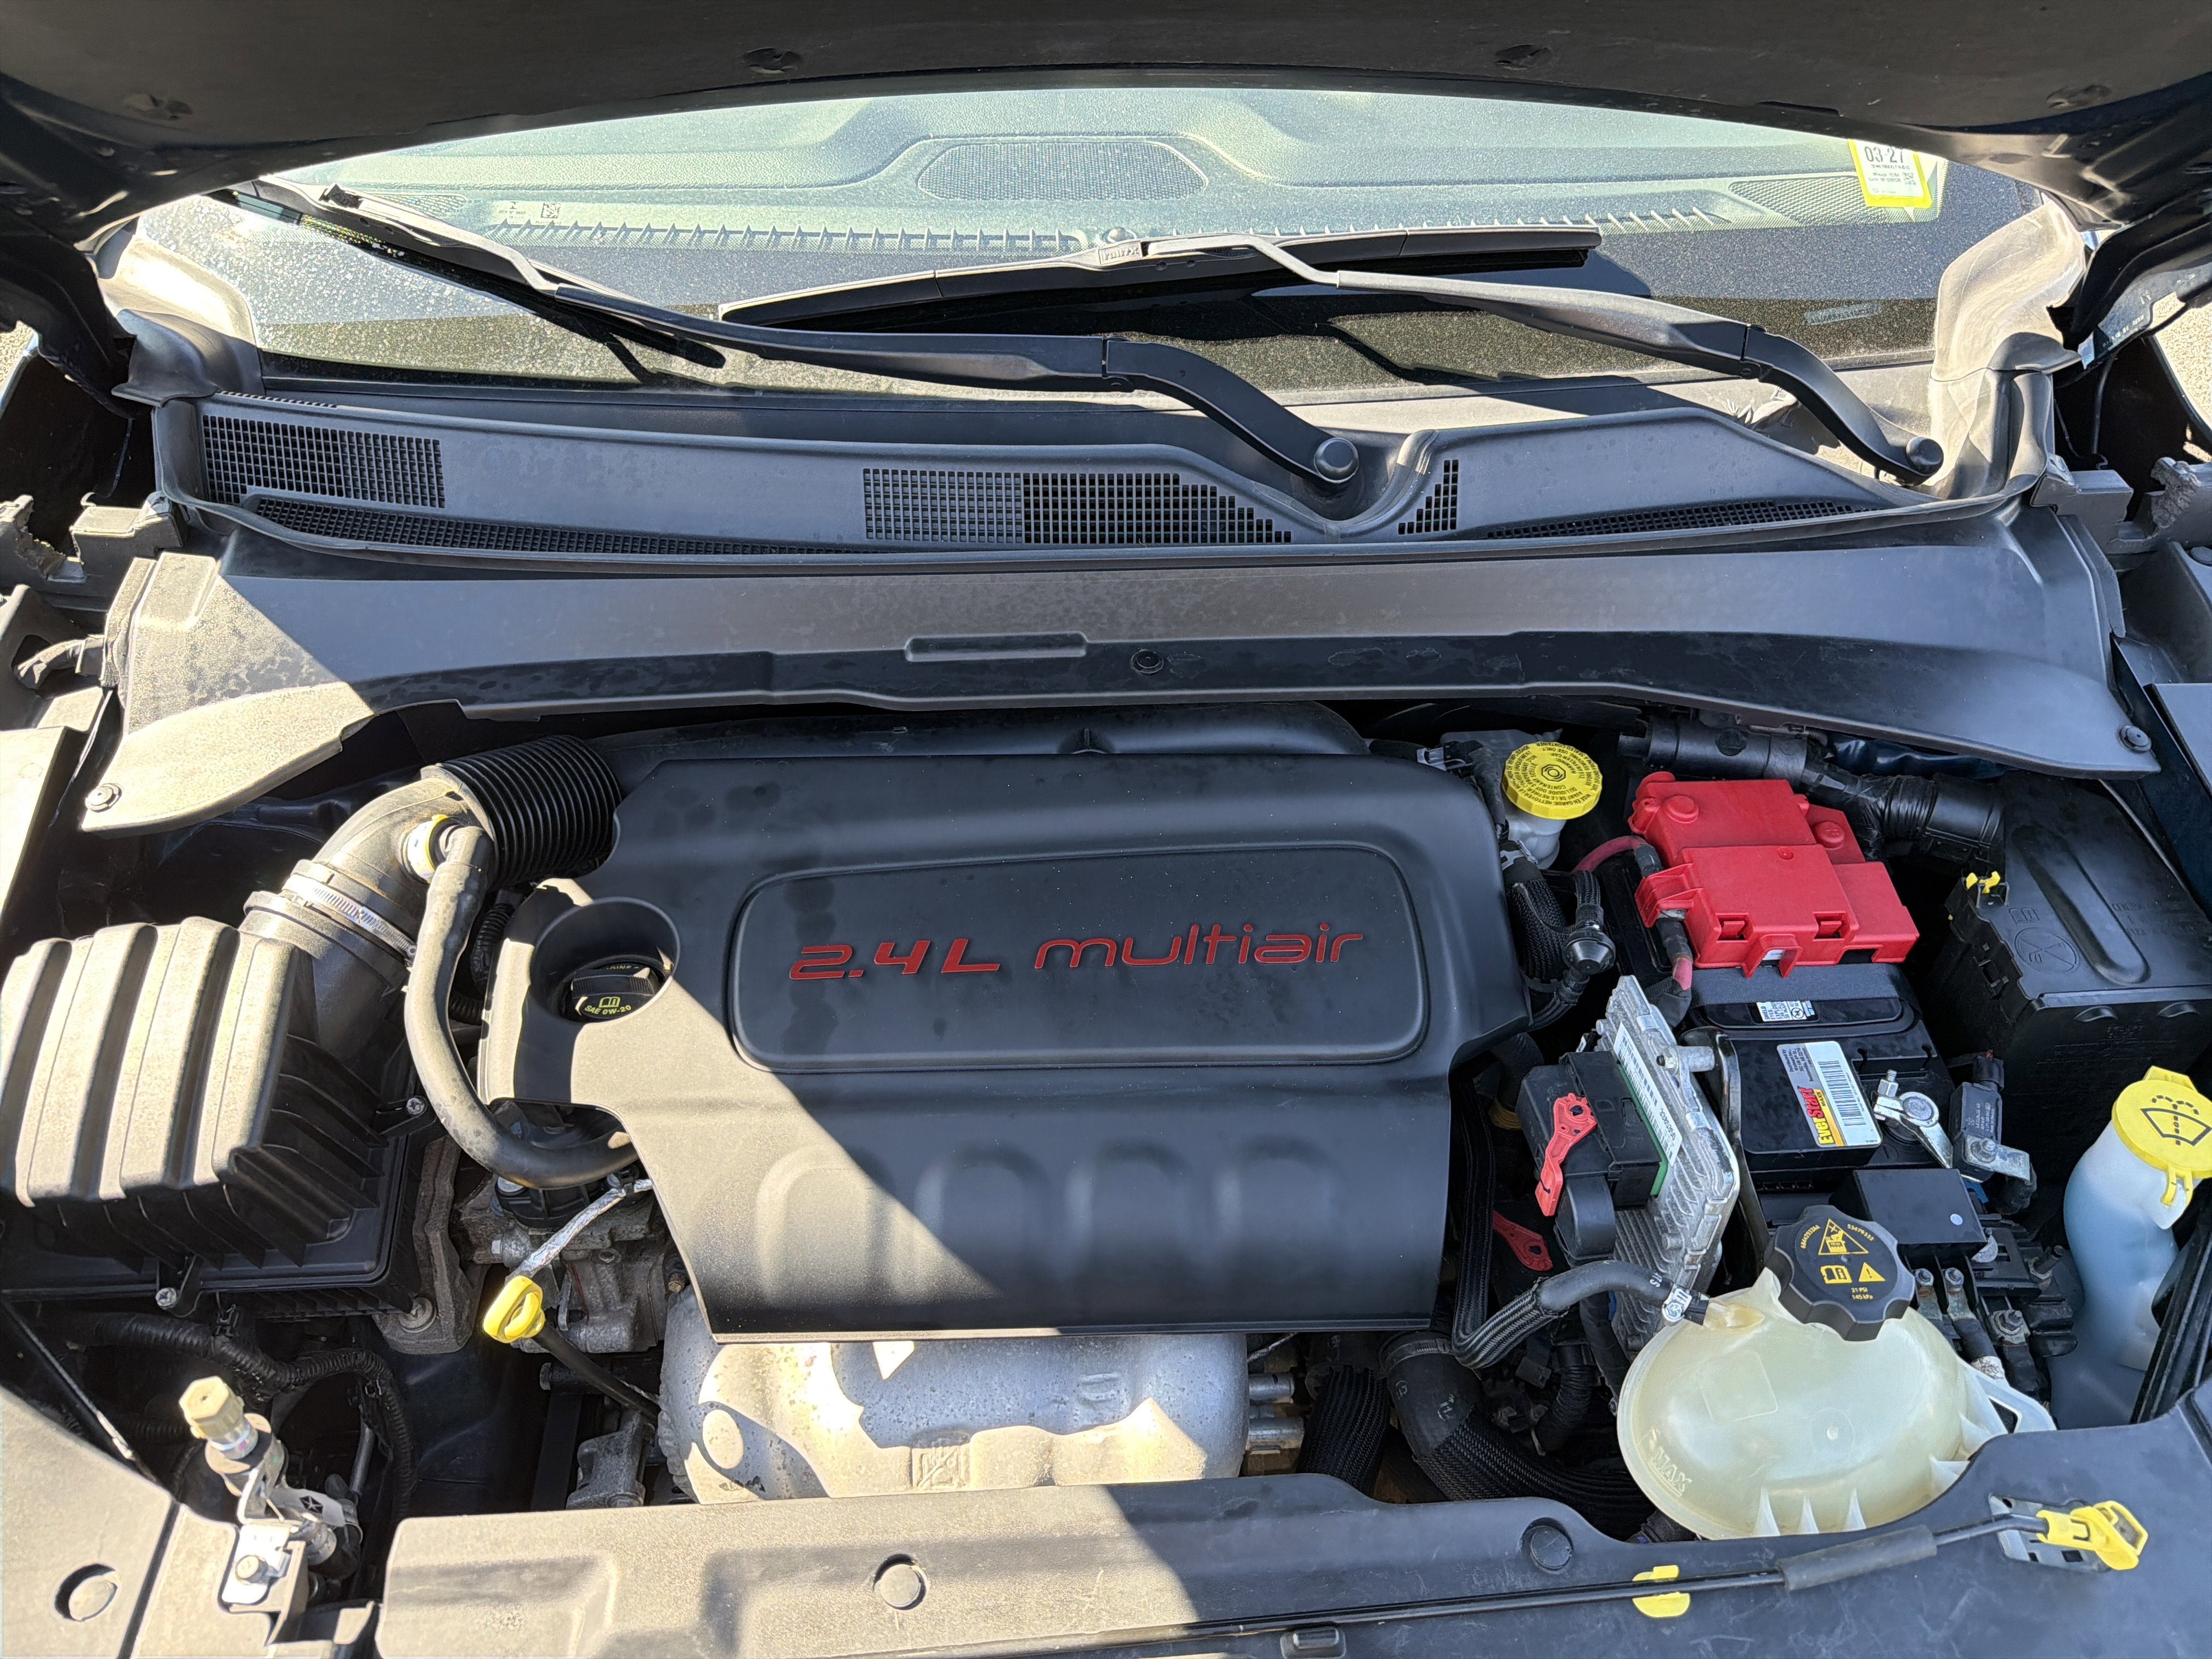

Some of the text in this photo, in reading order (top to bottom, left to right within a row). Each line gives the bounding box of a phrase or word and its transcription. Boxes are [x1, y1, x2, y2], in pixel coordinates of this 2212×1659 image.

[1566, 746, 1585, 757] SEALED
[1555, 758, 1578, 774] WARNING:
[1562, 755, 1579, 766] FILLER
[1586, 759, 1597, 770] FROM
[1575, 766, 1585, 778] CLEAN
[1533, 778, 1567, 791] CONTENANT
[1567, 791, 1583, 799] AVANT
[1579, 793, 1591, 801] MISE
[1034, 923, 1364, 970] multiair
[584, 1005, 632, 1015] SAE 0W-20
[1760, 1006, 1770, 1019] SHIELD
[1815, 1091, 1826, 1106] MAXX
[1797, 1088, 1835, 1144] EverStart
[1650, 1446, 1692, 1491] MAX
